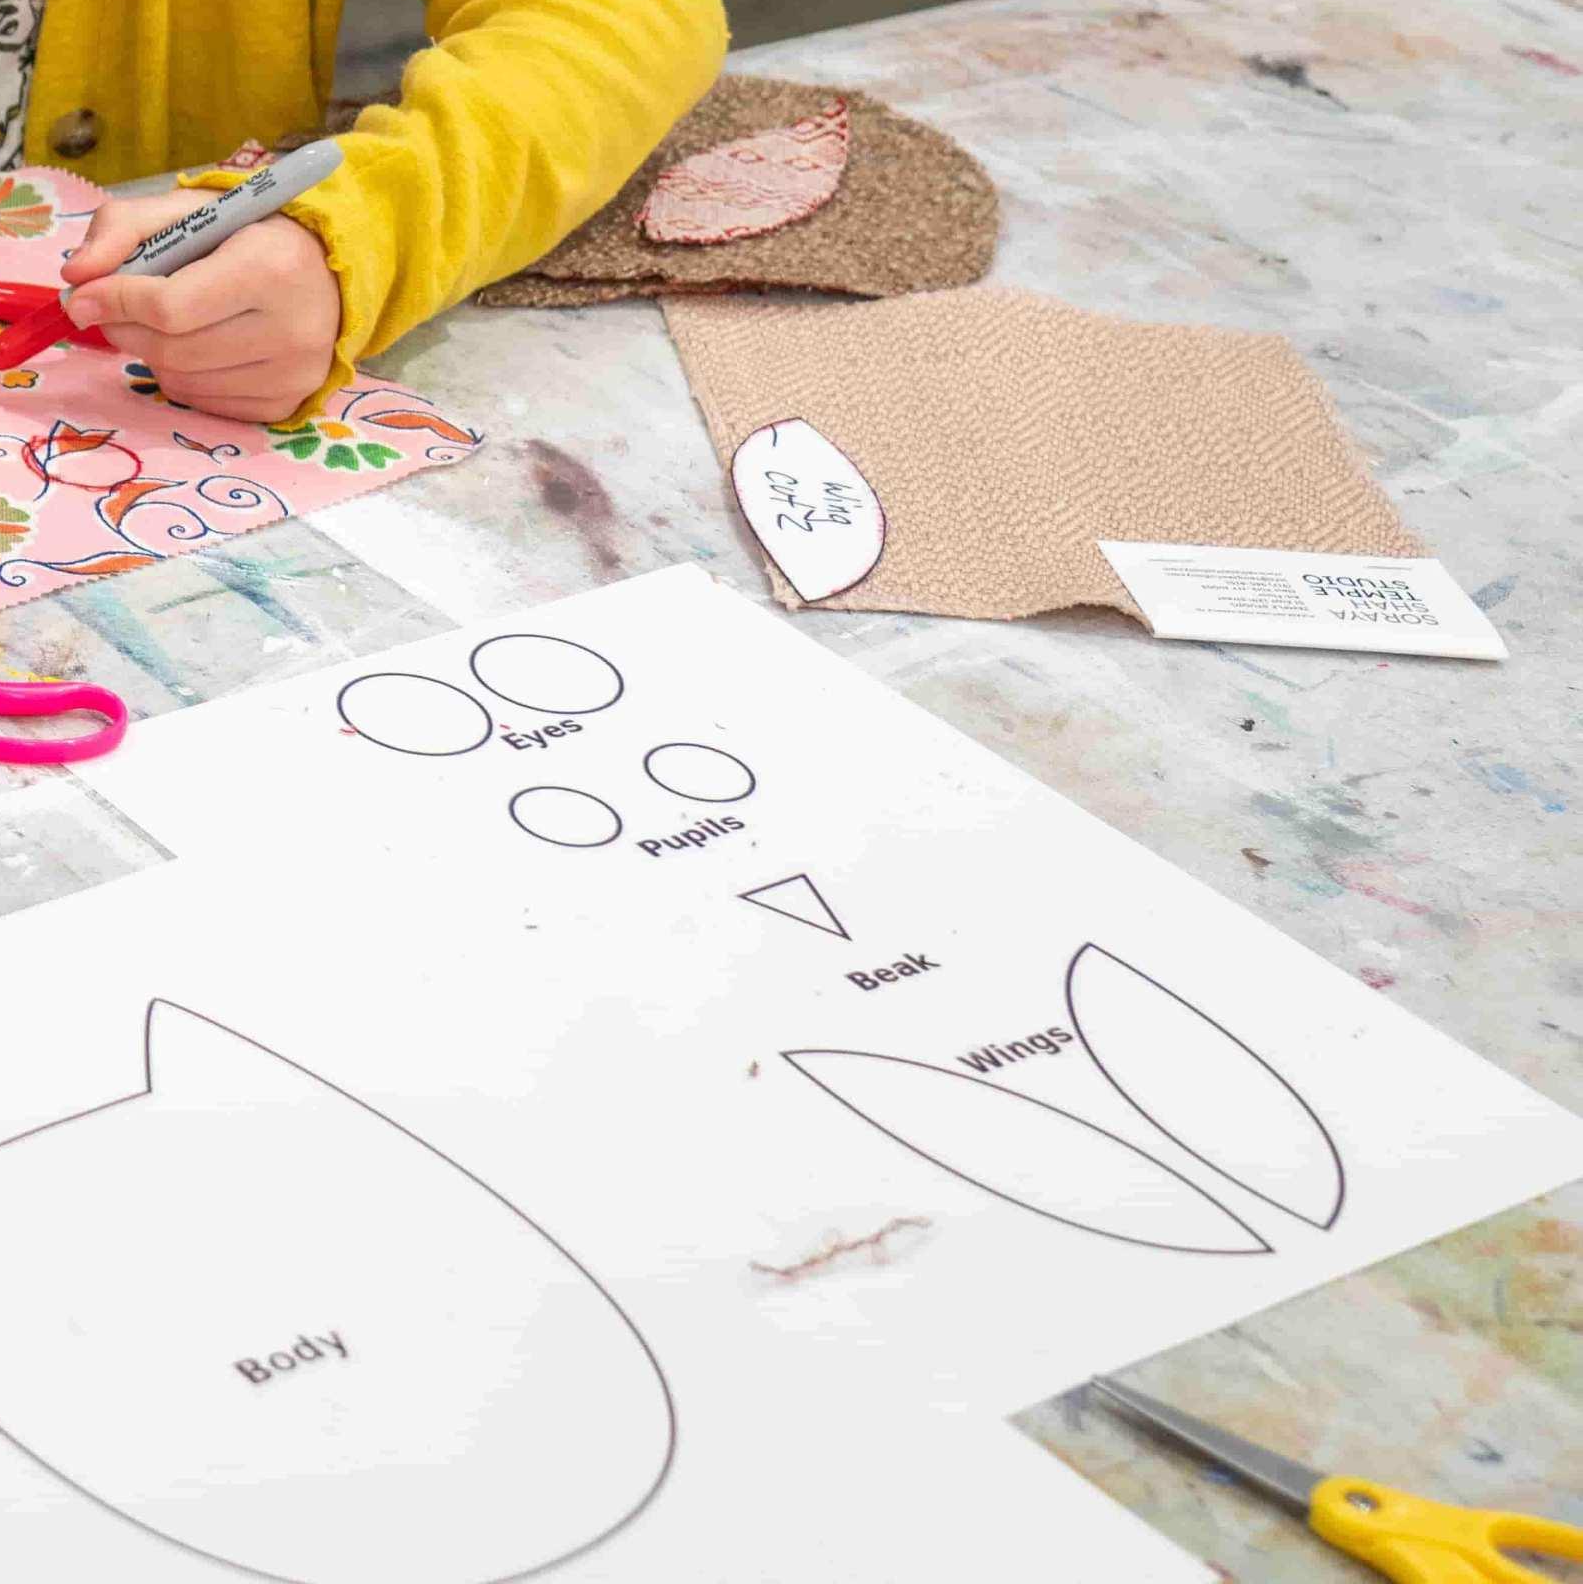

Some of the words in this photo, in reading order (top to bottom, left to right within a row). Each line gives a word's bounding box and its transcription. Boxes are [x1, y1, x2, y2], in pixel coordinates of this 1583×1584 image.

[143, 233, 186, 262] Permanent
[190, 214, 219, 234] Marker
[776, 513, 814, 532] 2
[1301, 573, 1410, 590] STUDIO
[1311, 585, 1423, 603] TEMPLE
[1328, 609, 1440, 627] SORAYA
[1350, 599, 1430, 614] SHAH
[500, 716, 584, 752] Eyes
[636, 812, 747, 858] Pupils
[844, 950, 943, 992] Beak
[956, 1023, 1074, 1076] Wings
[233, 1330, 350, 1385] Body
